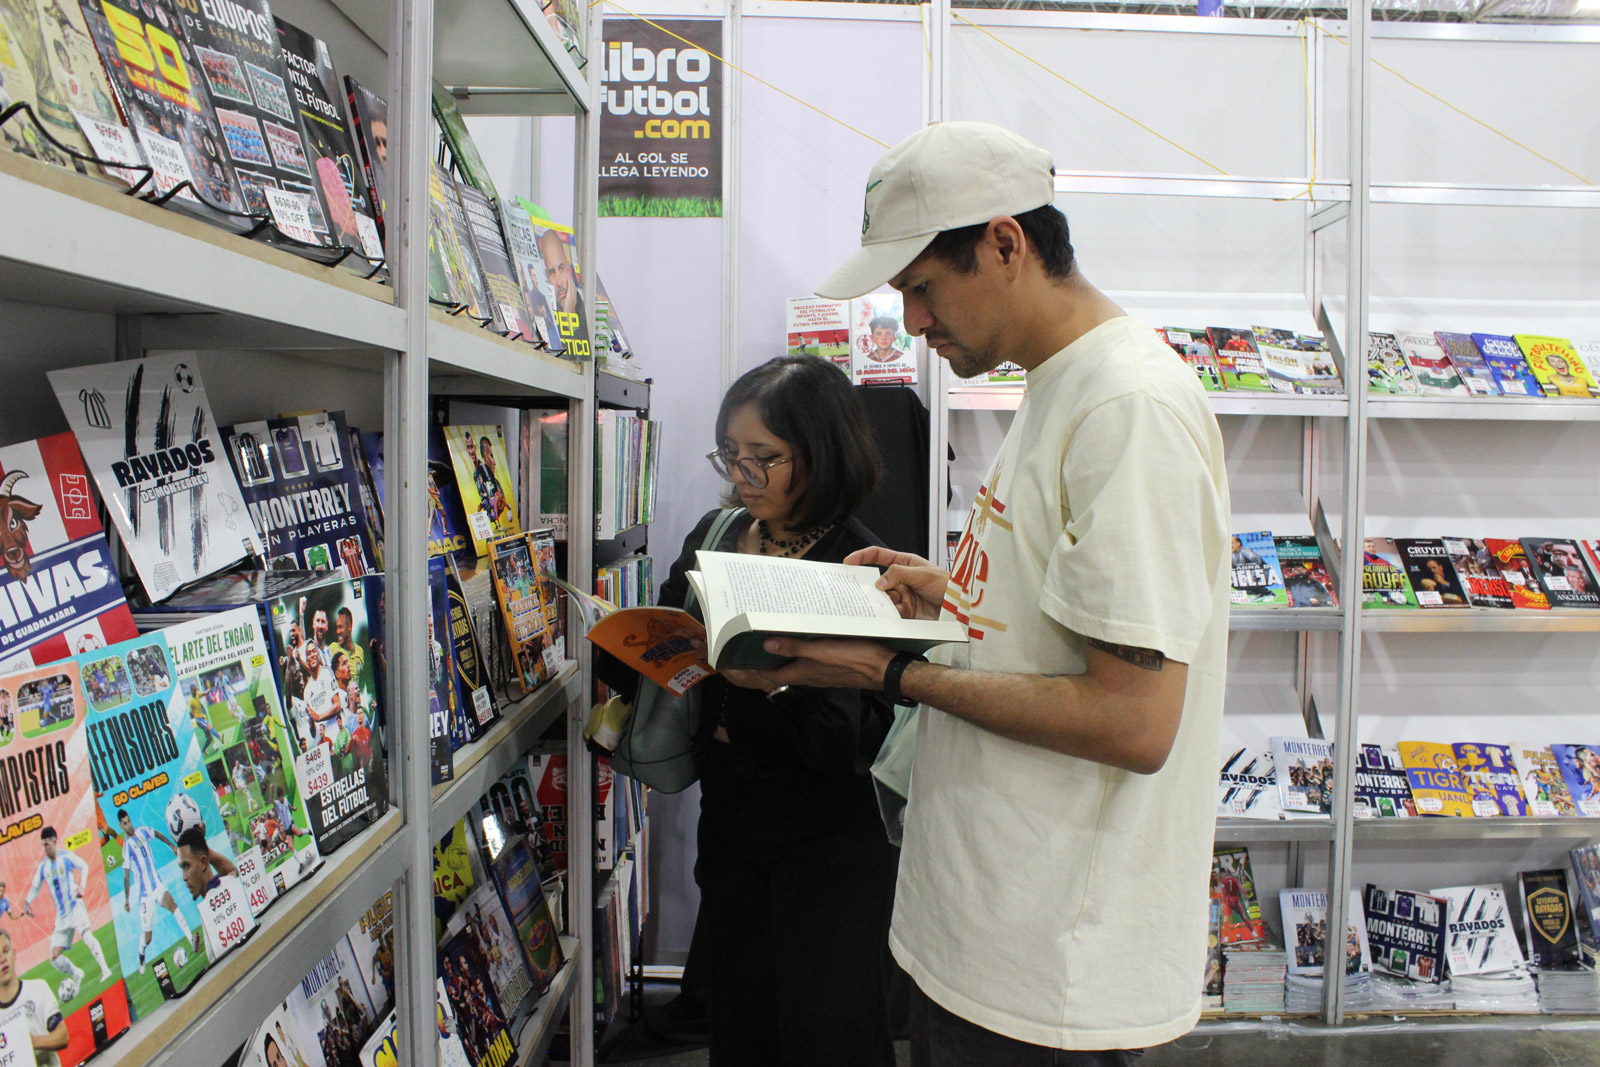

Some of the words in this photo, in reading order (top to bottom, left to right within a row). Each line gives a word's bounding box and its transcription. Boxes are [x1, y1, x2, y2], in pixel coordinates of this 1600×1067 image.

[185, 14, 204, 32] DE
[201, 0, 273, 45] EQUIPOS
[101, 0, 191, 93] 50
[209, 24, 275, 60] LEYENDAS
[281, 47, 318, 78] FACTOR
[135, 89, 160, 108] DEL
[165, 100, 207, 128] FÚTBOL
[294, 87, 309, 106] EL
[306, 92, 342, 121] FÚTBOL
[634, 119, 711, 139] .com
[169, 163, 185, 177] OFF
[614, 152, 634, 164] AL
[638, 152, 667, 164] GOL
[671, 152, 688, 164] SE
[644, 166, 709, 178] LEYENDO
[289, 212, 305, 225] OFF
[1529, 342, 1585, 375] FUTBOLTELLING
[111, 438, 217, 489] RAYADOS
[139, 487, 157, 504] DE
[154, 470, 210, 499] MONTERREY
[248, 482, 353, 535] MONTERREY
[261, 533, 282, 549] EN
[288, 515, 357, 541] PLAYERAS
[1, 632, 15, 644] DE
[15, 605, 77, 640] GUADALAJARA
[169, 645, 181, 667] EL
[182, 637, 206, 663] ARTE
[206, 633, 223, 656] DEL
[223, 622, 255, 651] ENGAÑO
[176, 667, 184, 677] LA
[198, 654, 227, 670] DEFINITIVA
[227, 651, 237, 661] DEL
[237, 645, 255, 656] REGATE
[305, 767, 316, 777] 10%
[315, 760, 325, 773] OFF
[307, 772, 329, 796] $439
[1220, 773, 1277, 786] AYADOS
[113, 790, 130, 808] 50
[128, 771, 170, 800] CLAVES
[320, 767, 366, 808] ESTRELLAS
[321, 805, 339, 828] DEL
[338, 785, 370, 818] FÚTBOL
[250, 872, 261, 885] OFF
[209, 888, 231, 912] $533
[250, 885, 269, 908] 480
[1535, 903, 1564, 914] RAYADAS
[213, 912, 226, 926] 10%
[225, 902, 238, 917] OFF
[1449, 918, 1506, 934] RAYADOS
[218, 916, 245, 948] $480
[1367, 917, 1440, 948] MONTERREY
[1384, 937, 1437, 954] PLAYERAS
